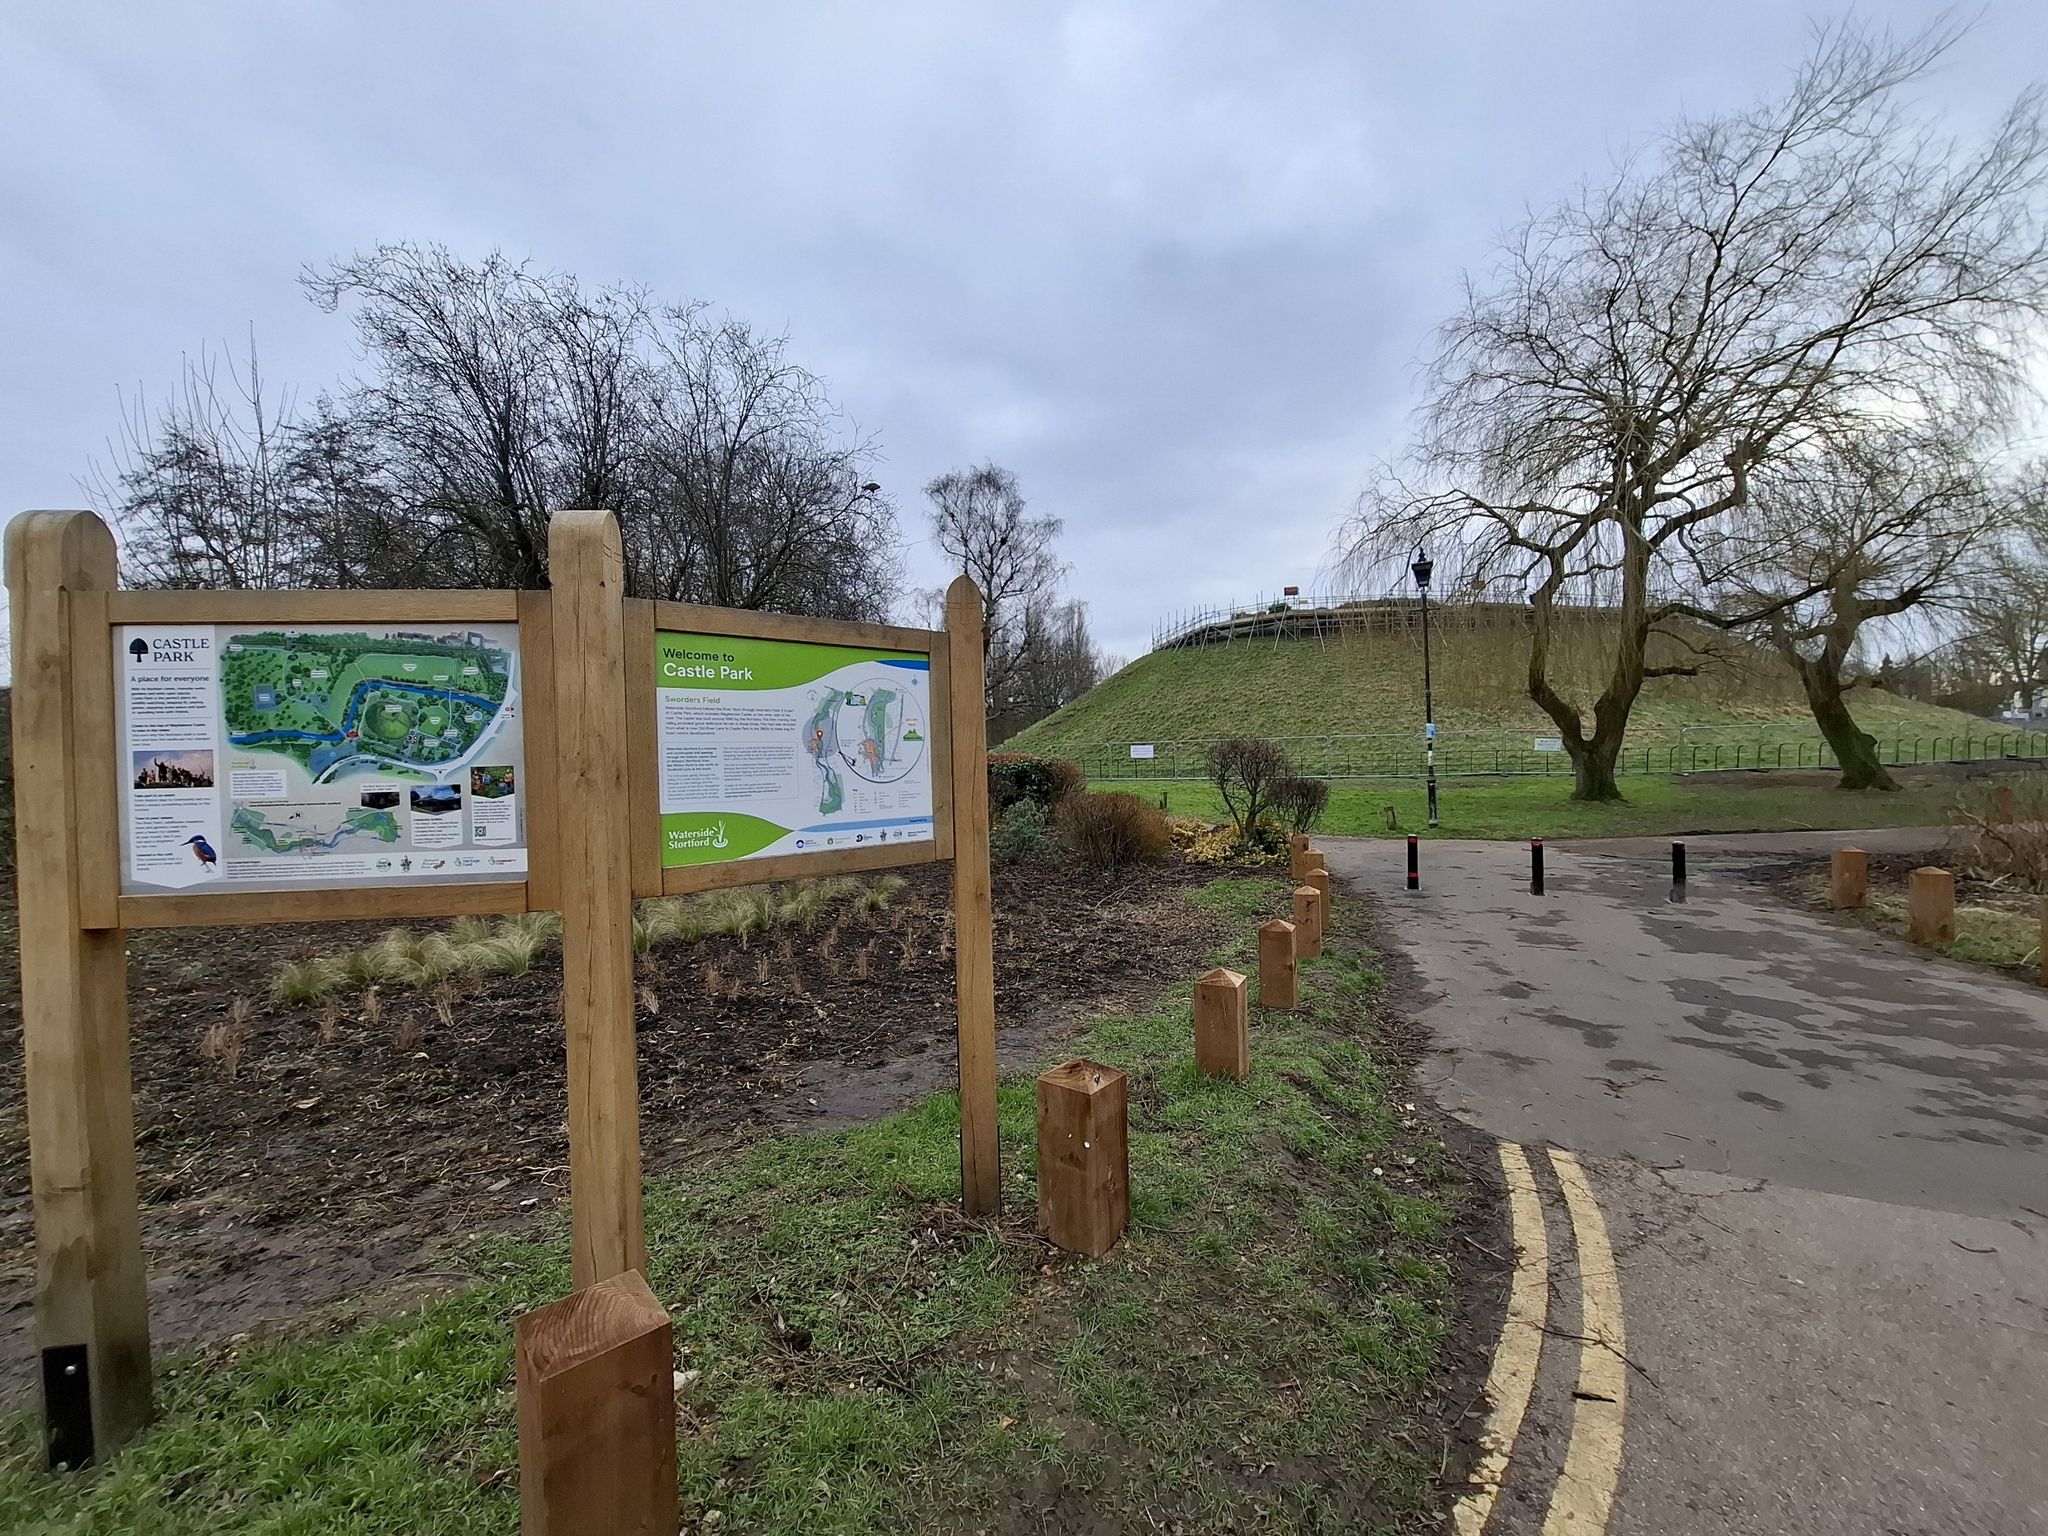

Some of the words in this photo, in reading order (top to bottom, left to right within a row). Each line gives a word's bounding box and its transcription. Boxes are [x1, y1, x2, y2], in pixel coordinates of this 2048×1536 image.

[152, 638, 210, 649] CASTLE
[154, 652, 194, 662] PARK
[663, 648, 719, 661] Welcome
[723, 653, 734, 662] to
[664, 662, 715, 678] Castle
[720, 666, 753, 680] Park
[665, 696, 700, 704] Sworders
[668, 828, 714, 839] Waterside
[668, 838, 710, 848] Stortford
